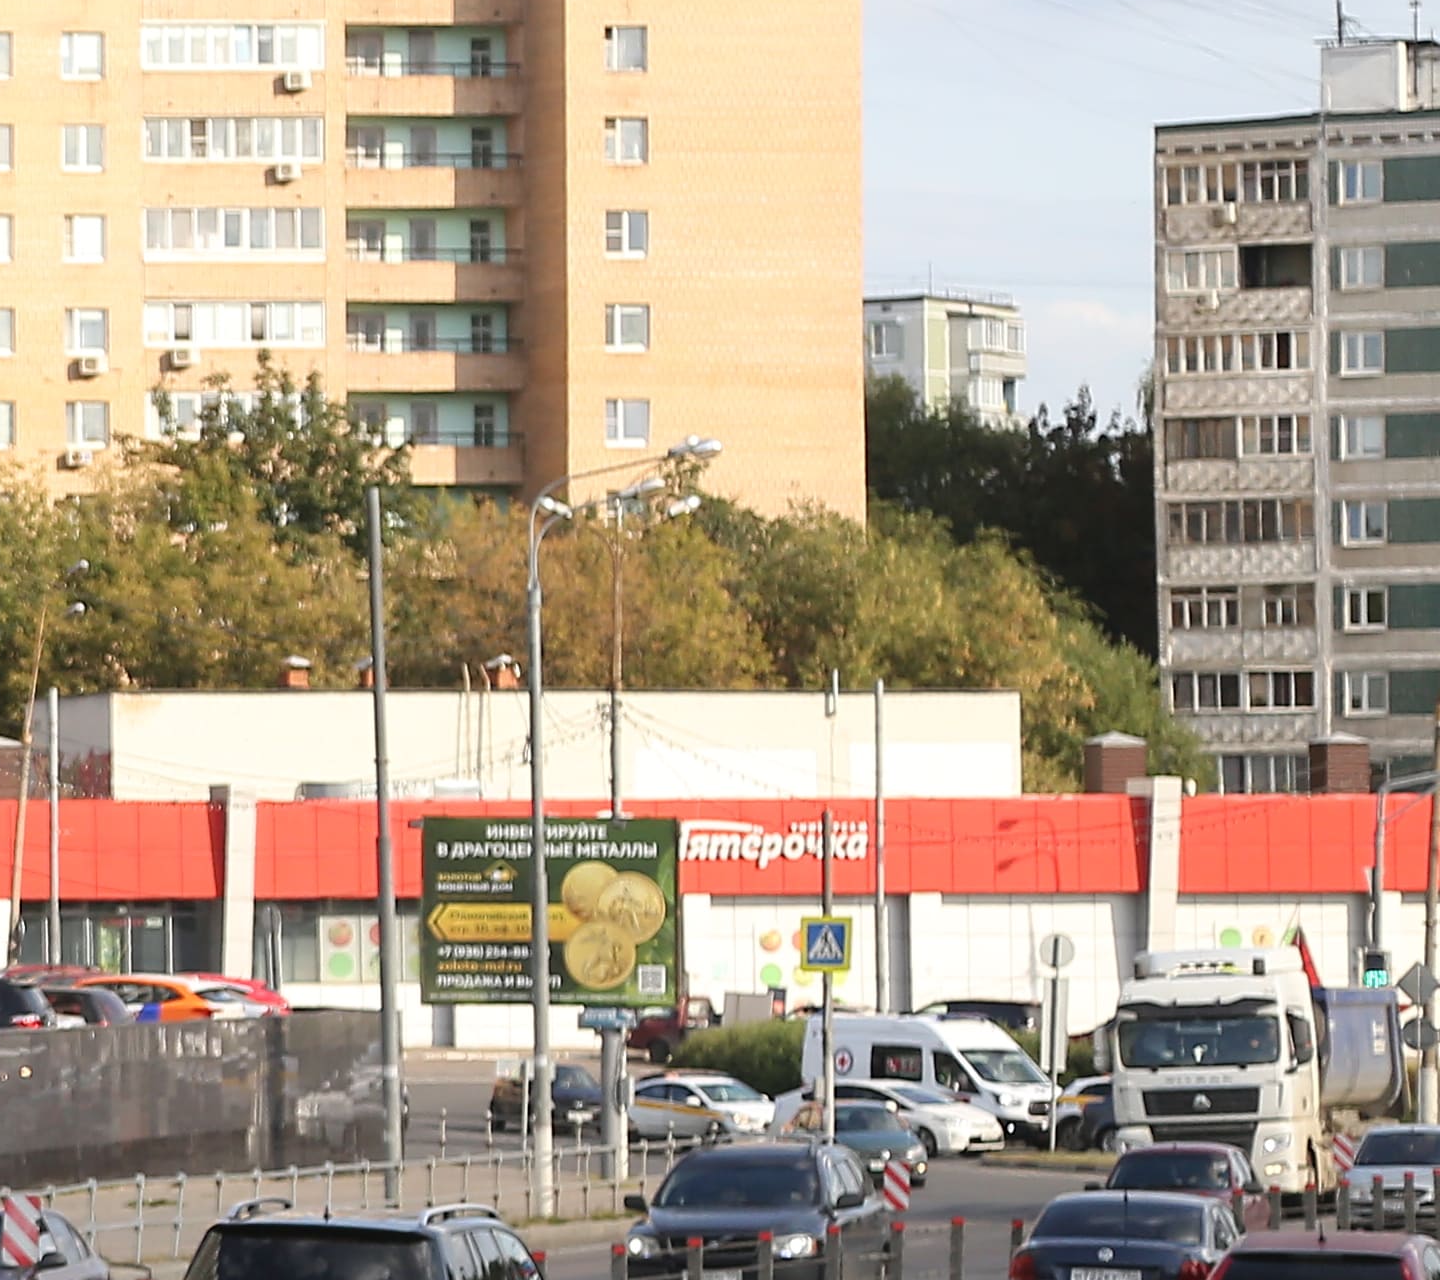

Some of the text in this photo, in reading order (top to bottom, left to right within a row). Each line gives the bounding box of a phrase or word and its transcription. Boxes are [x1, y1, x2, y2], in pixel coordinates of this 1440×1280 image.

[485, 822, 608, 840] ИНВЕИРУЙТЕ
[436, 842, 448, 858] В
[576, 841, 658, 859] МЕТАЛЛЫ
[437, 974, 502, 989] ПРОДАЖА
[504, 975, 514, 988] И
